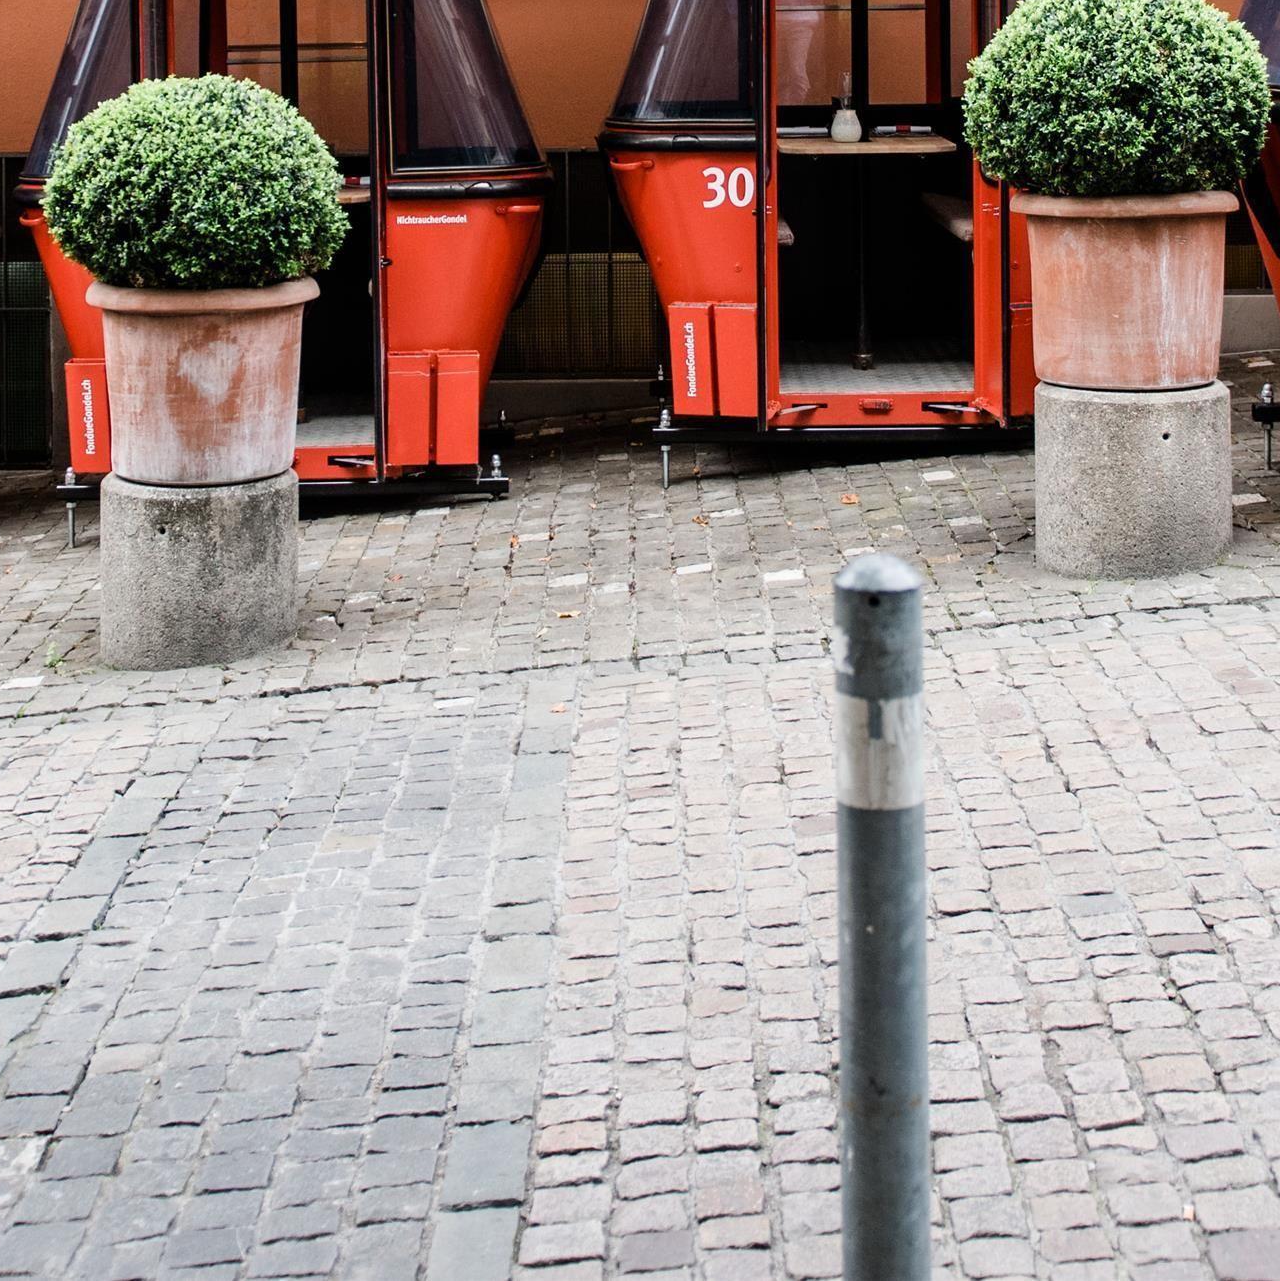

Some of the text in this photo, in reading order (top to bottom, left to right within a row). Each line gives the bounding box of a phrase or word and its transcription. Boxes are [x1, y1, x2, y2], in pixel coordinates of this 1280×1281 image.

[702, 166, 755, 208] 30
[683, 322, 697, 397] FondueGondel.ch
[81, 379, 95, 455] FondueGondel.ch
